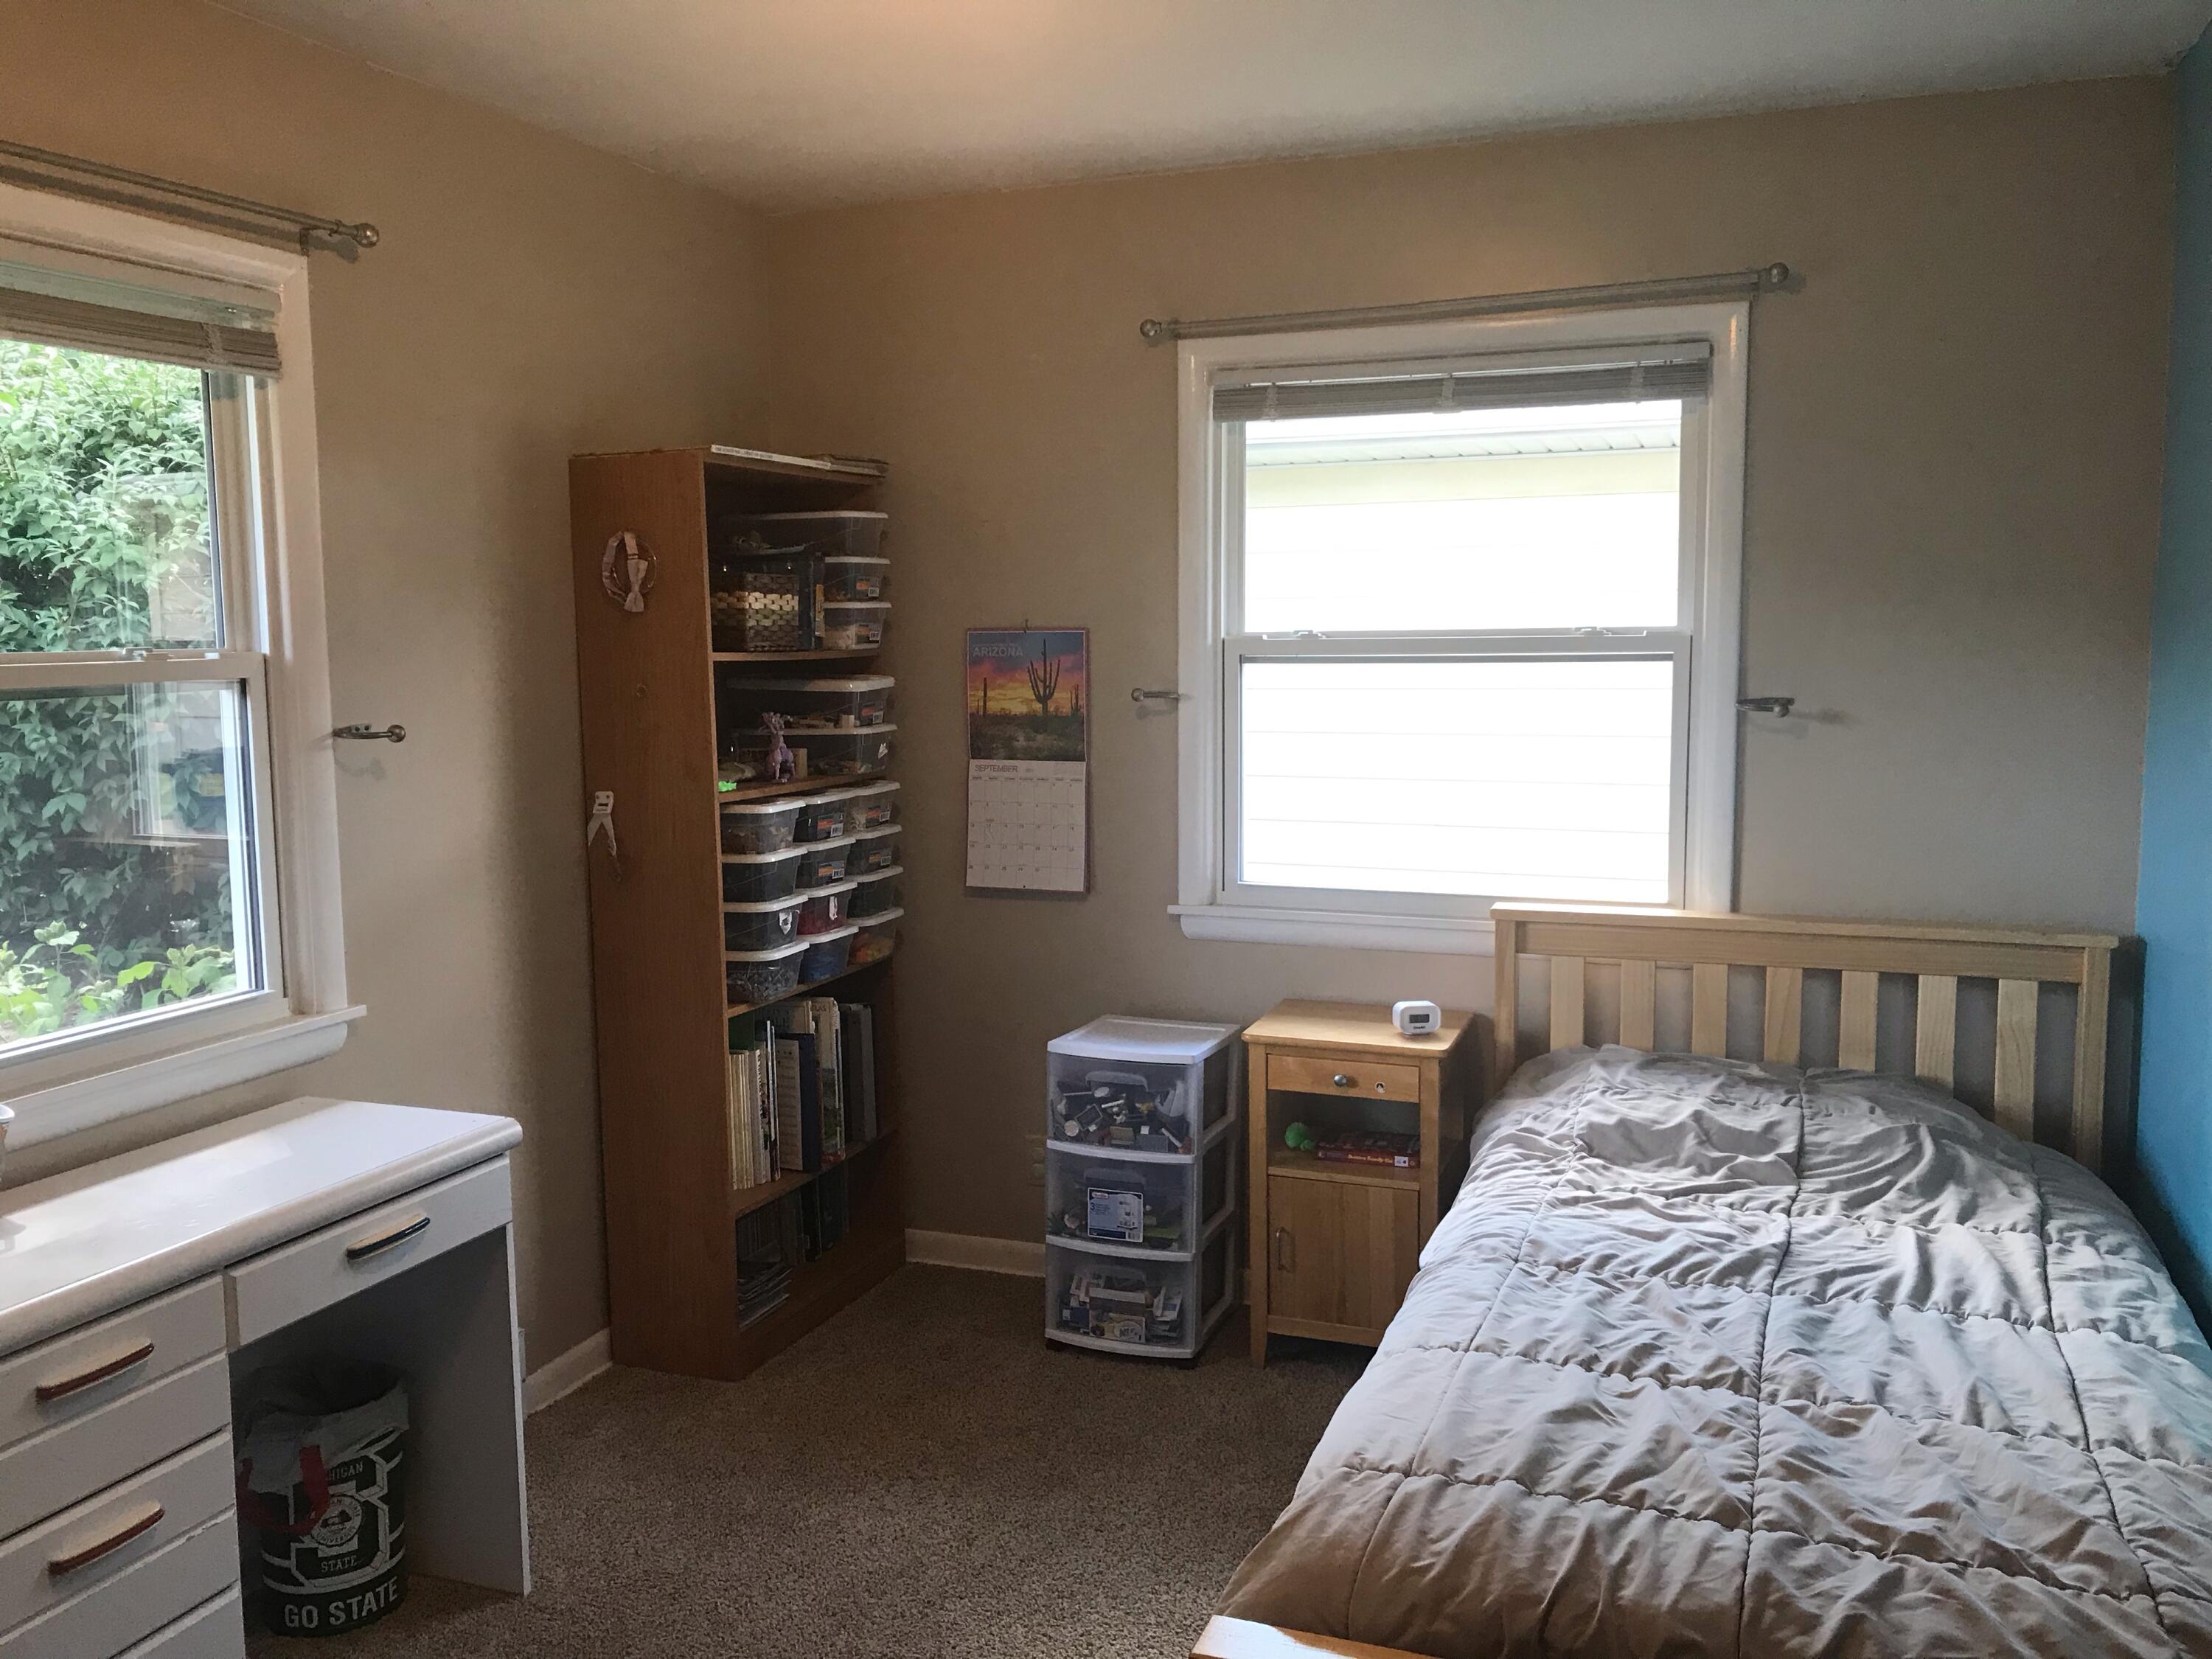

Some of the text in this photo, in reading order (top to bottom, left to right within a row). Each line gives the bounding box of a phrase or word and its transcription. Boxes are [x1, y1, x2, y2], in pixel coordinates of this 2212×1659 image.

[973, 647, 1023, 658] ARIZONA
[974, 765, 1018, 773] SEPTEMBER
[1090, 1203, 1095, 1211] 3
[320, 1555, 358, 1573] STATE
[284, 1575, 398, 1629] GO STATE
